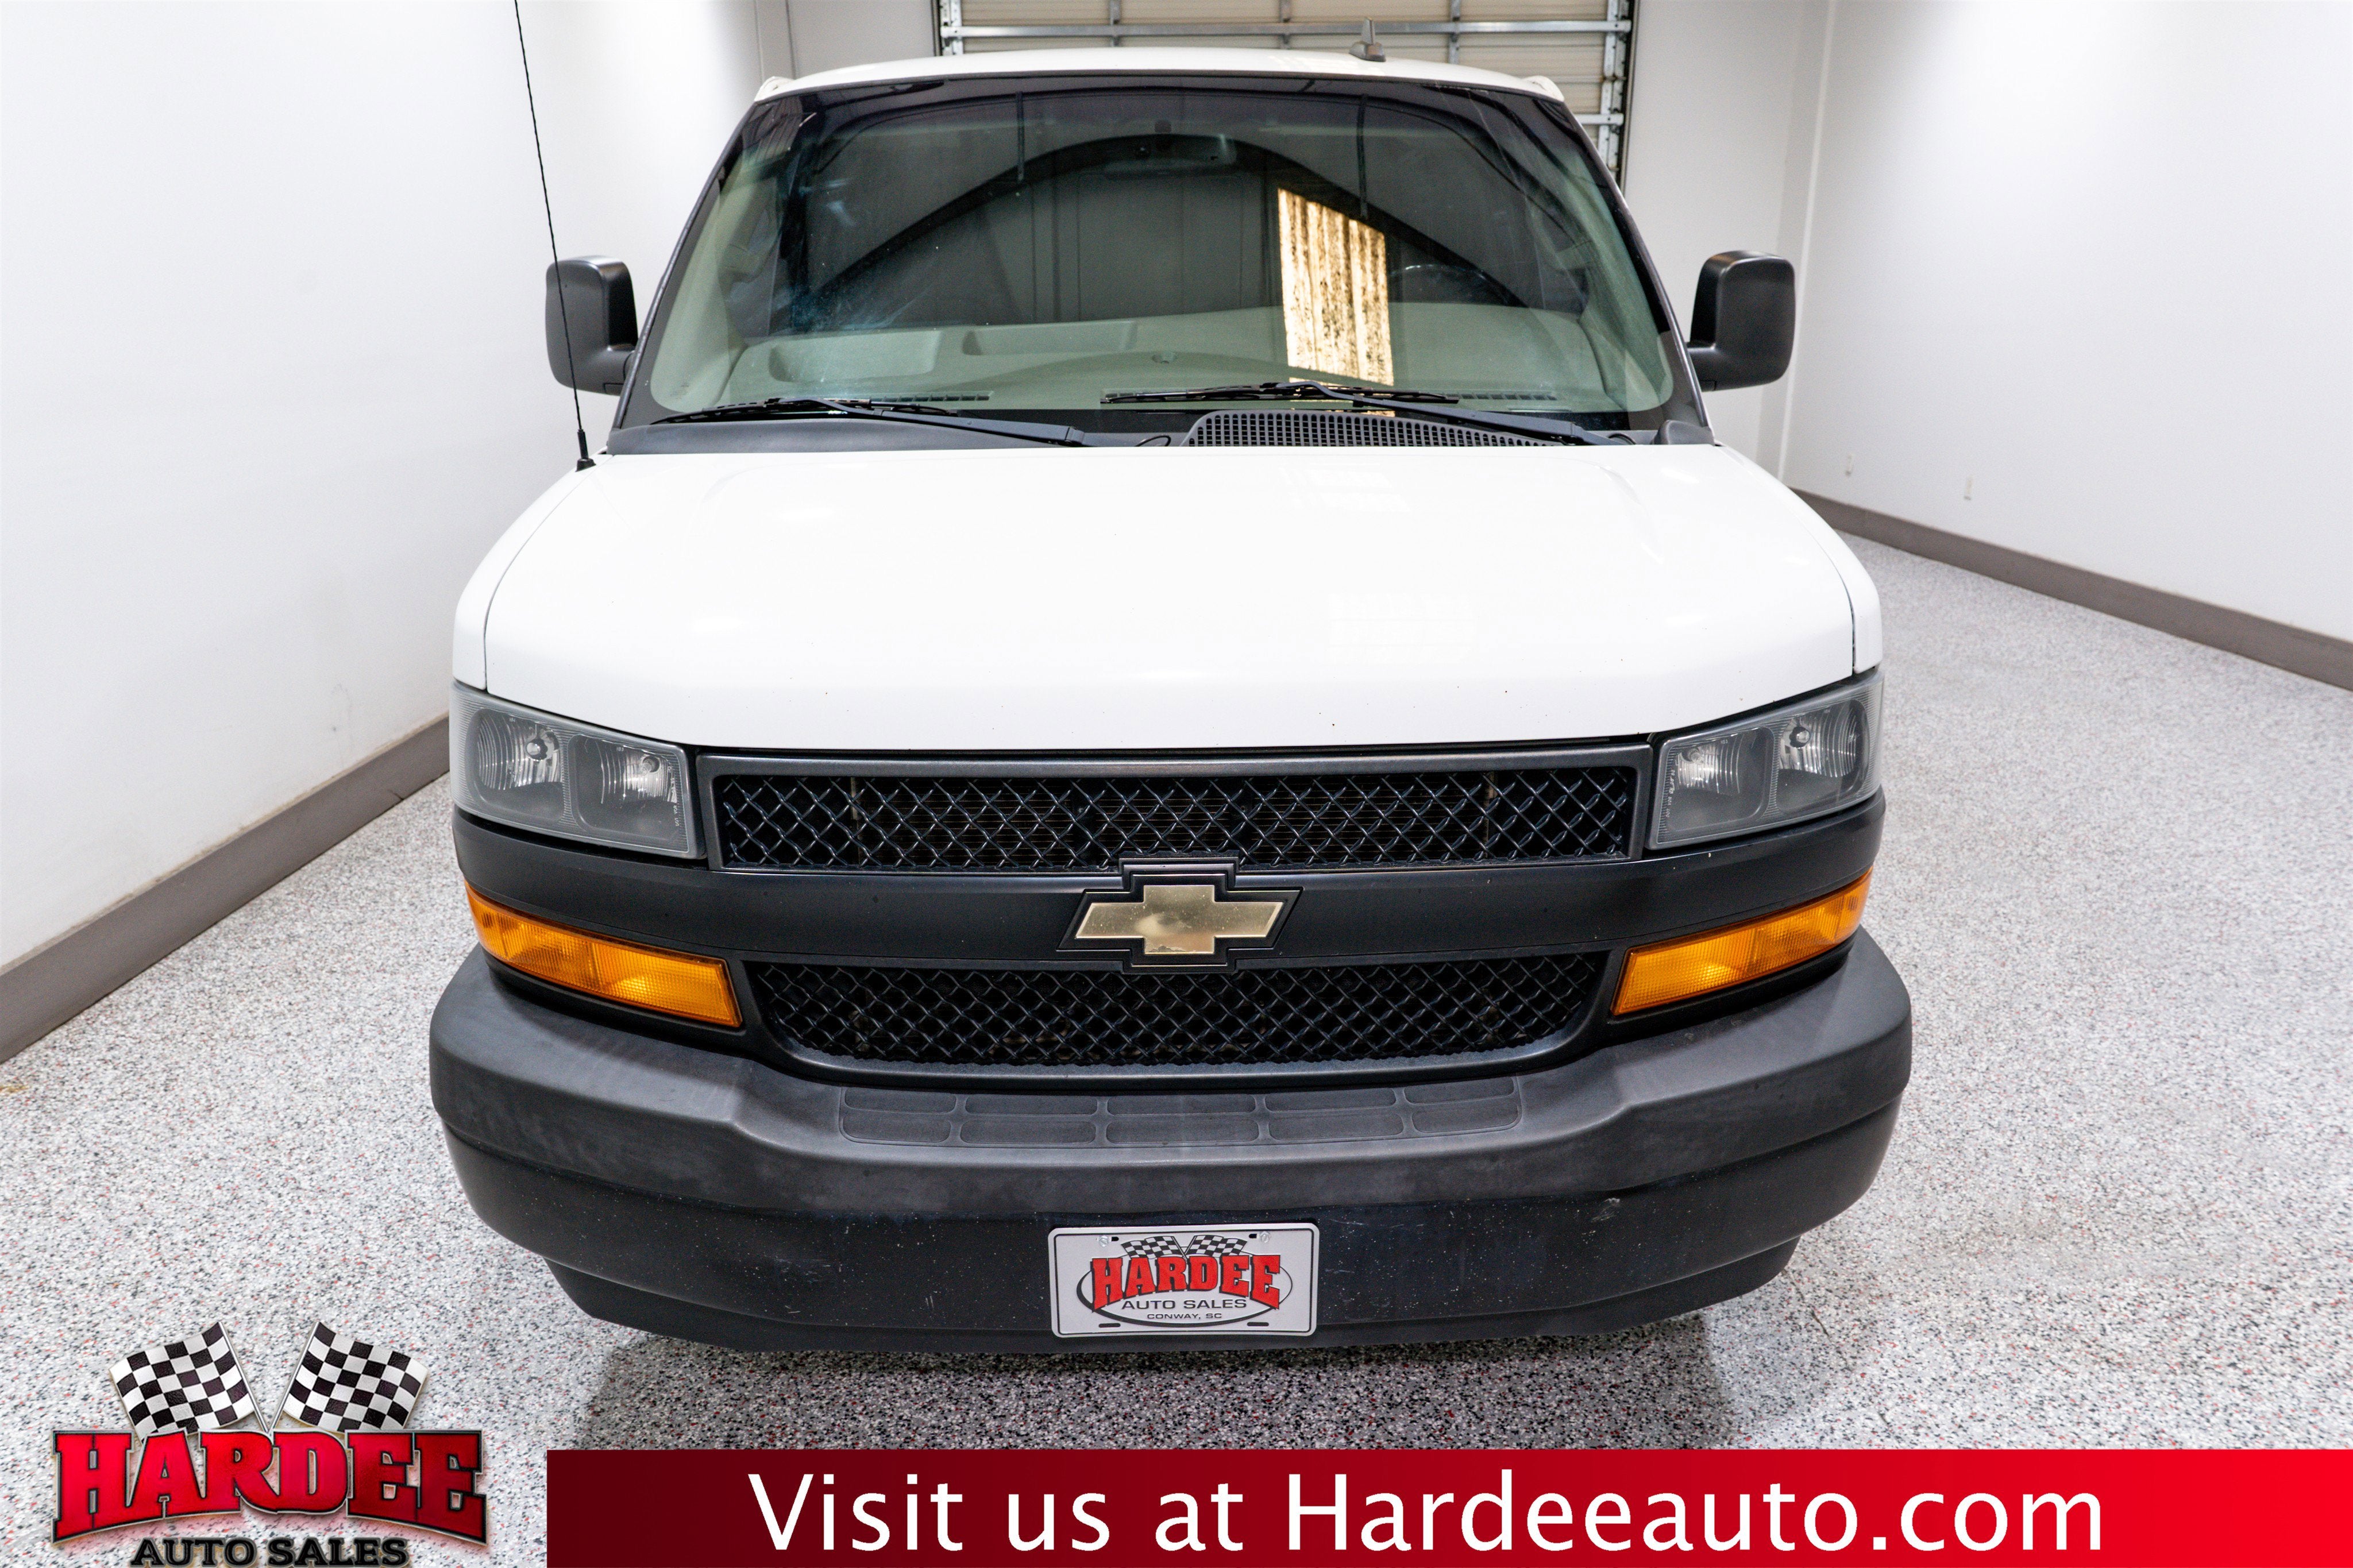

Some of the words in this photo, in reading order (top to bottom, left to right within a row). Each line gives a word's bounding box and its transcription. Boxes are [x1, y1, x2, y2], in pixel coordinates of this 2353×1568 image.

[1090, 1254, 1280, 1312] HARDEE
[1121, 1300, 1176, 1310] AUTO
[1183, 1299, 1247, 1310] SALES
